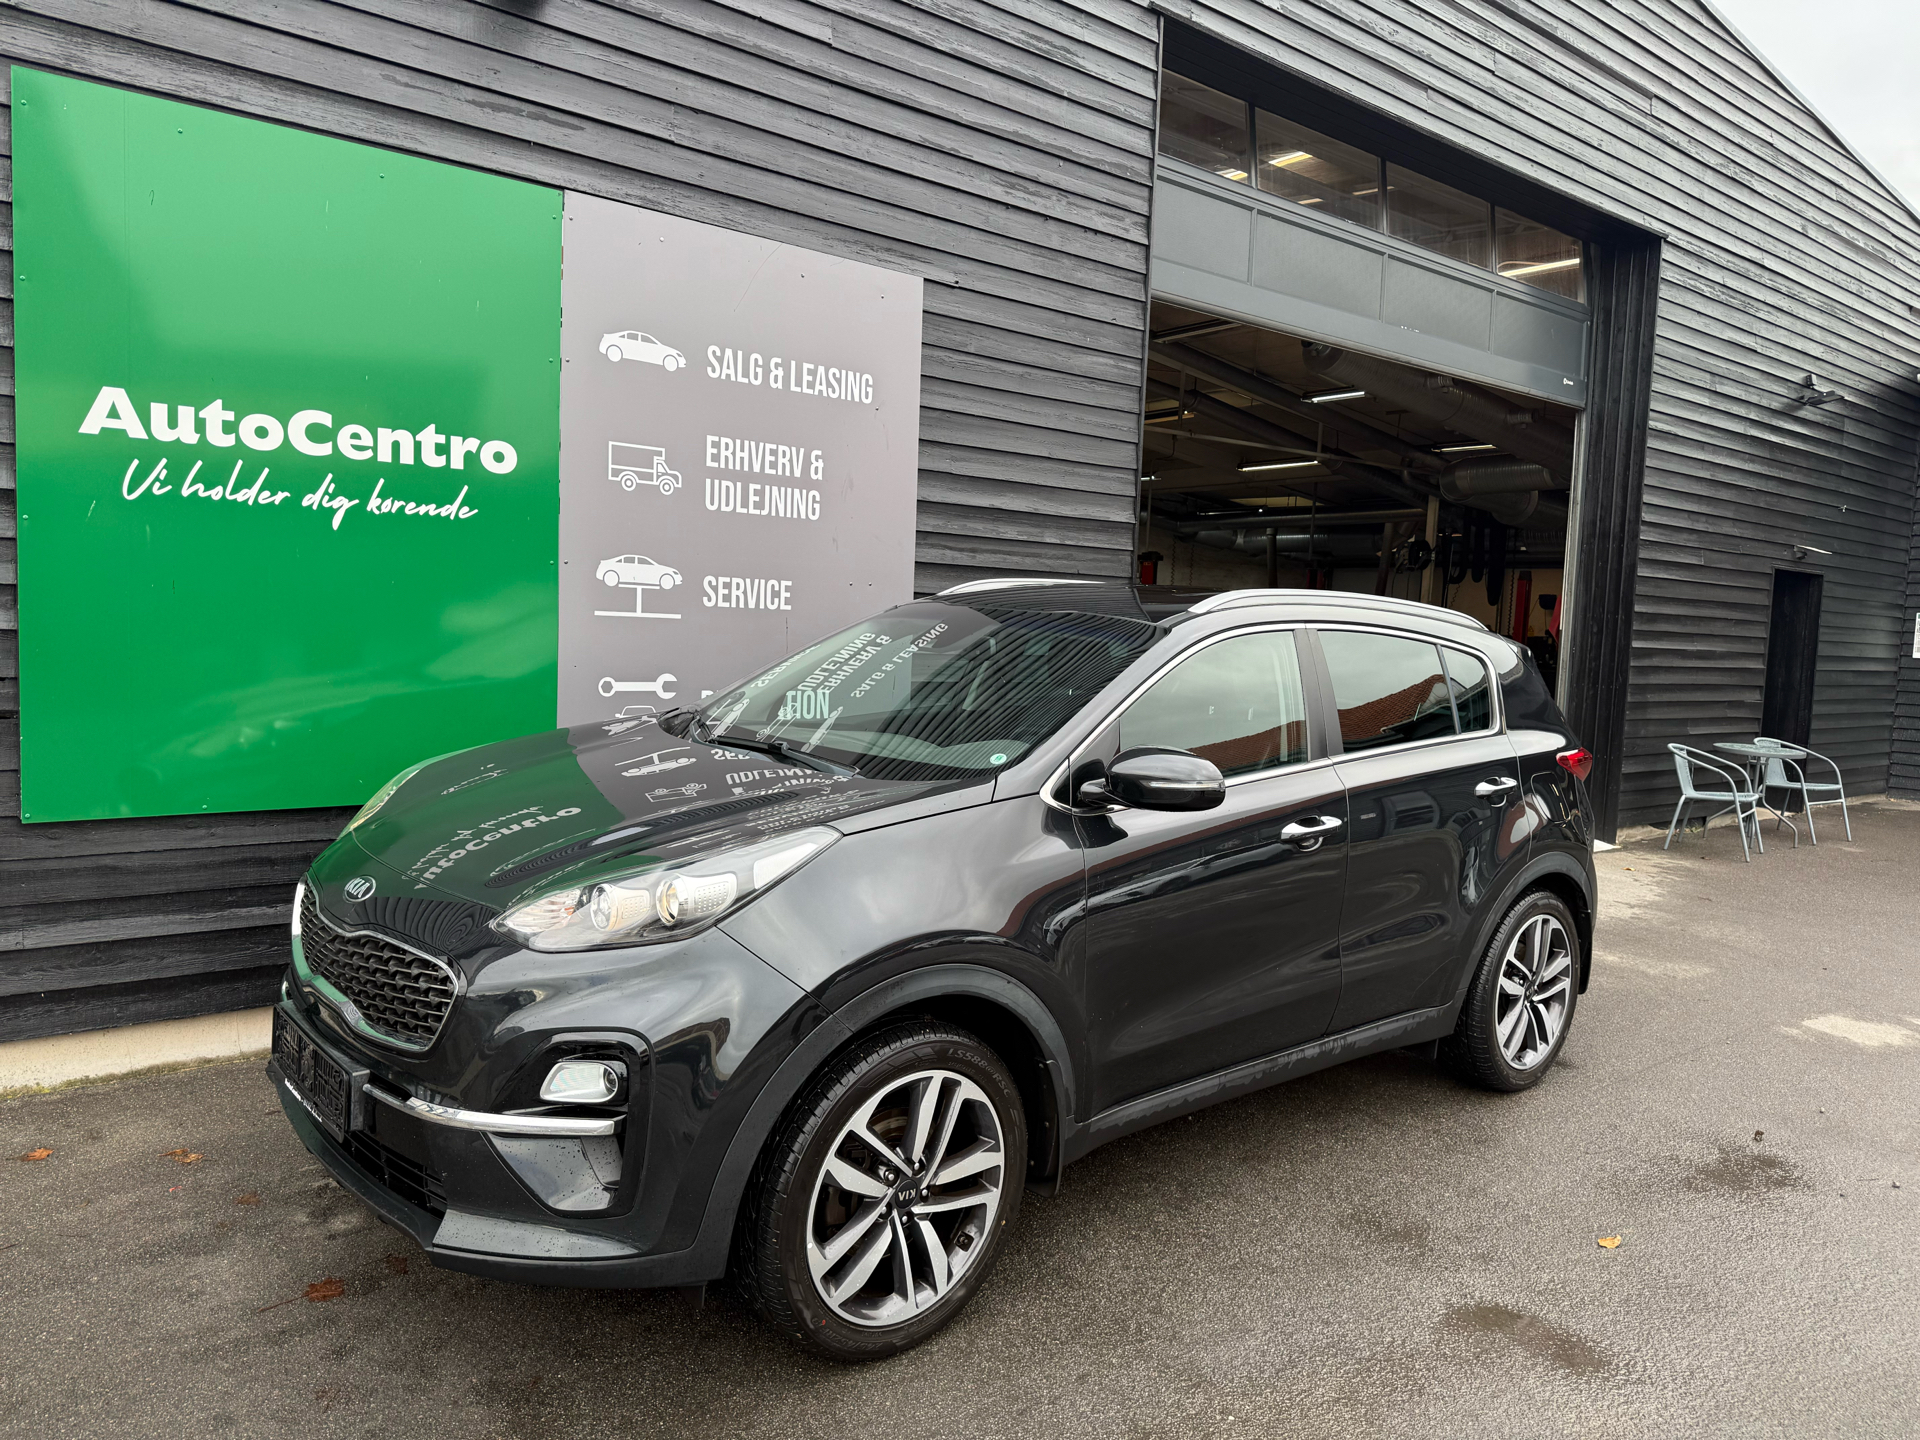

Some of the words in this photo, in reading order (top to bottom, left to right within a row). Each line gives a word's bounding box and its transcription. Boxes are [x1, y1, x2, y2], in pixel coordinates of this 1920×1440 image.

[707, 345, 763, 386] SALG
[769, 357, 784, 389] &
[790, 360, 874, 404] LEASING
[78, 386, 518, 474] AutoCentro
[706, 435, 804, 478] ERHVERV
[810, 449, 824, 480] &
[122, 458, 172, 501] Vi
[181, 460, 290, 506] holder
[302, 473, 359, 530] dig
[367, 478, 478, 520] kørende
[705, 478, 821, 521] UDLEJNING
[702, 575, 792, 611] SERVICE
[347, 877, 370, 898] KIA
[898, 1188, 916, 1201] KIA
